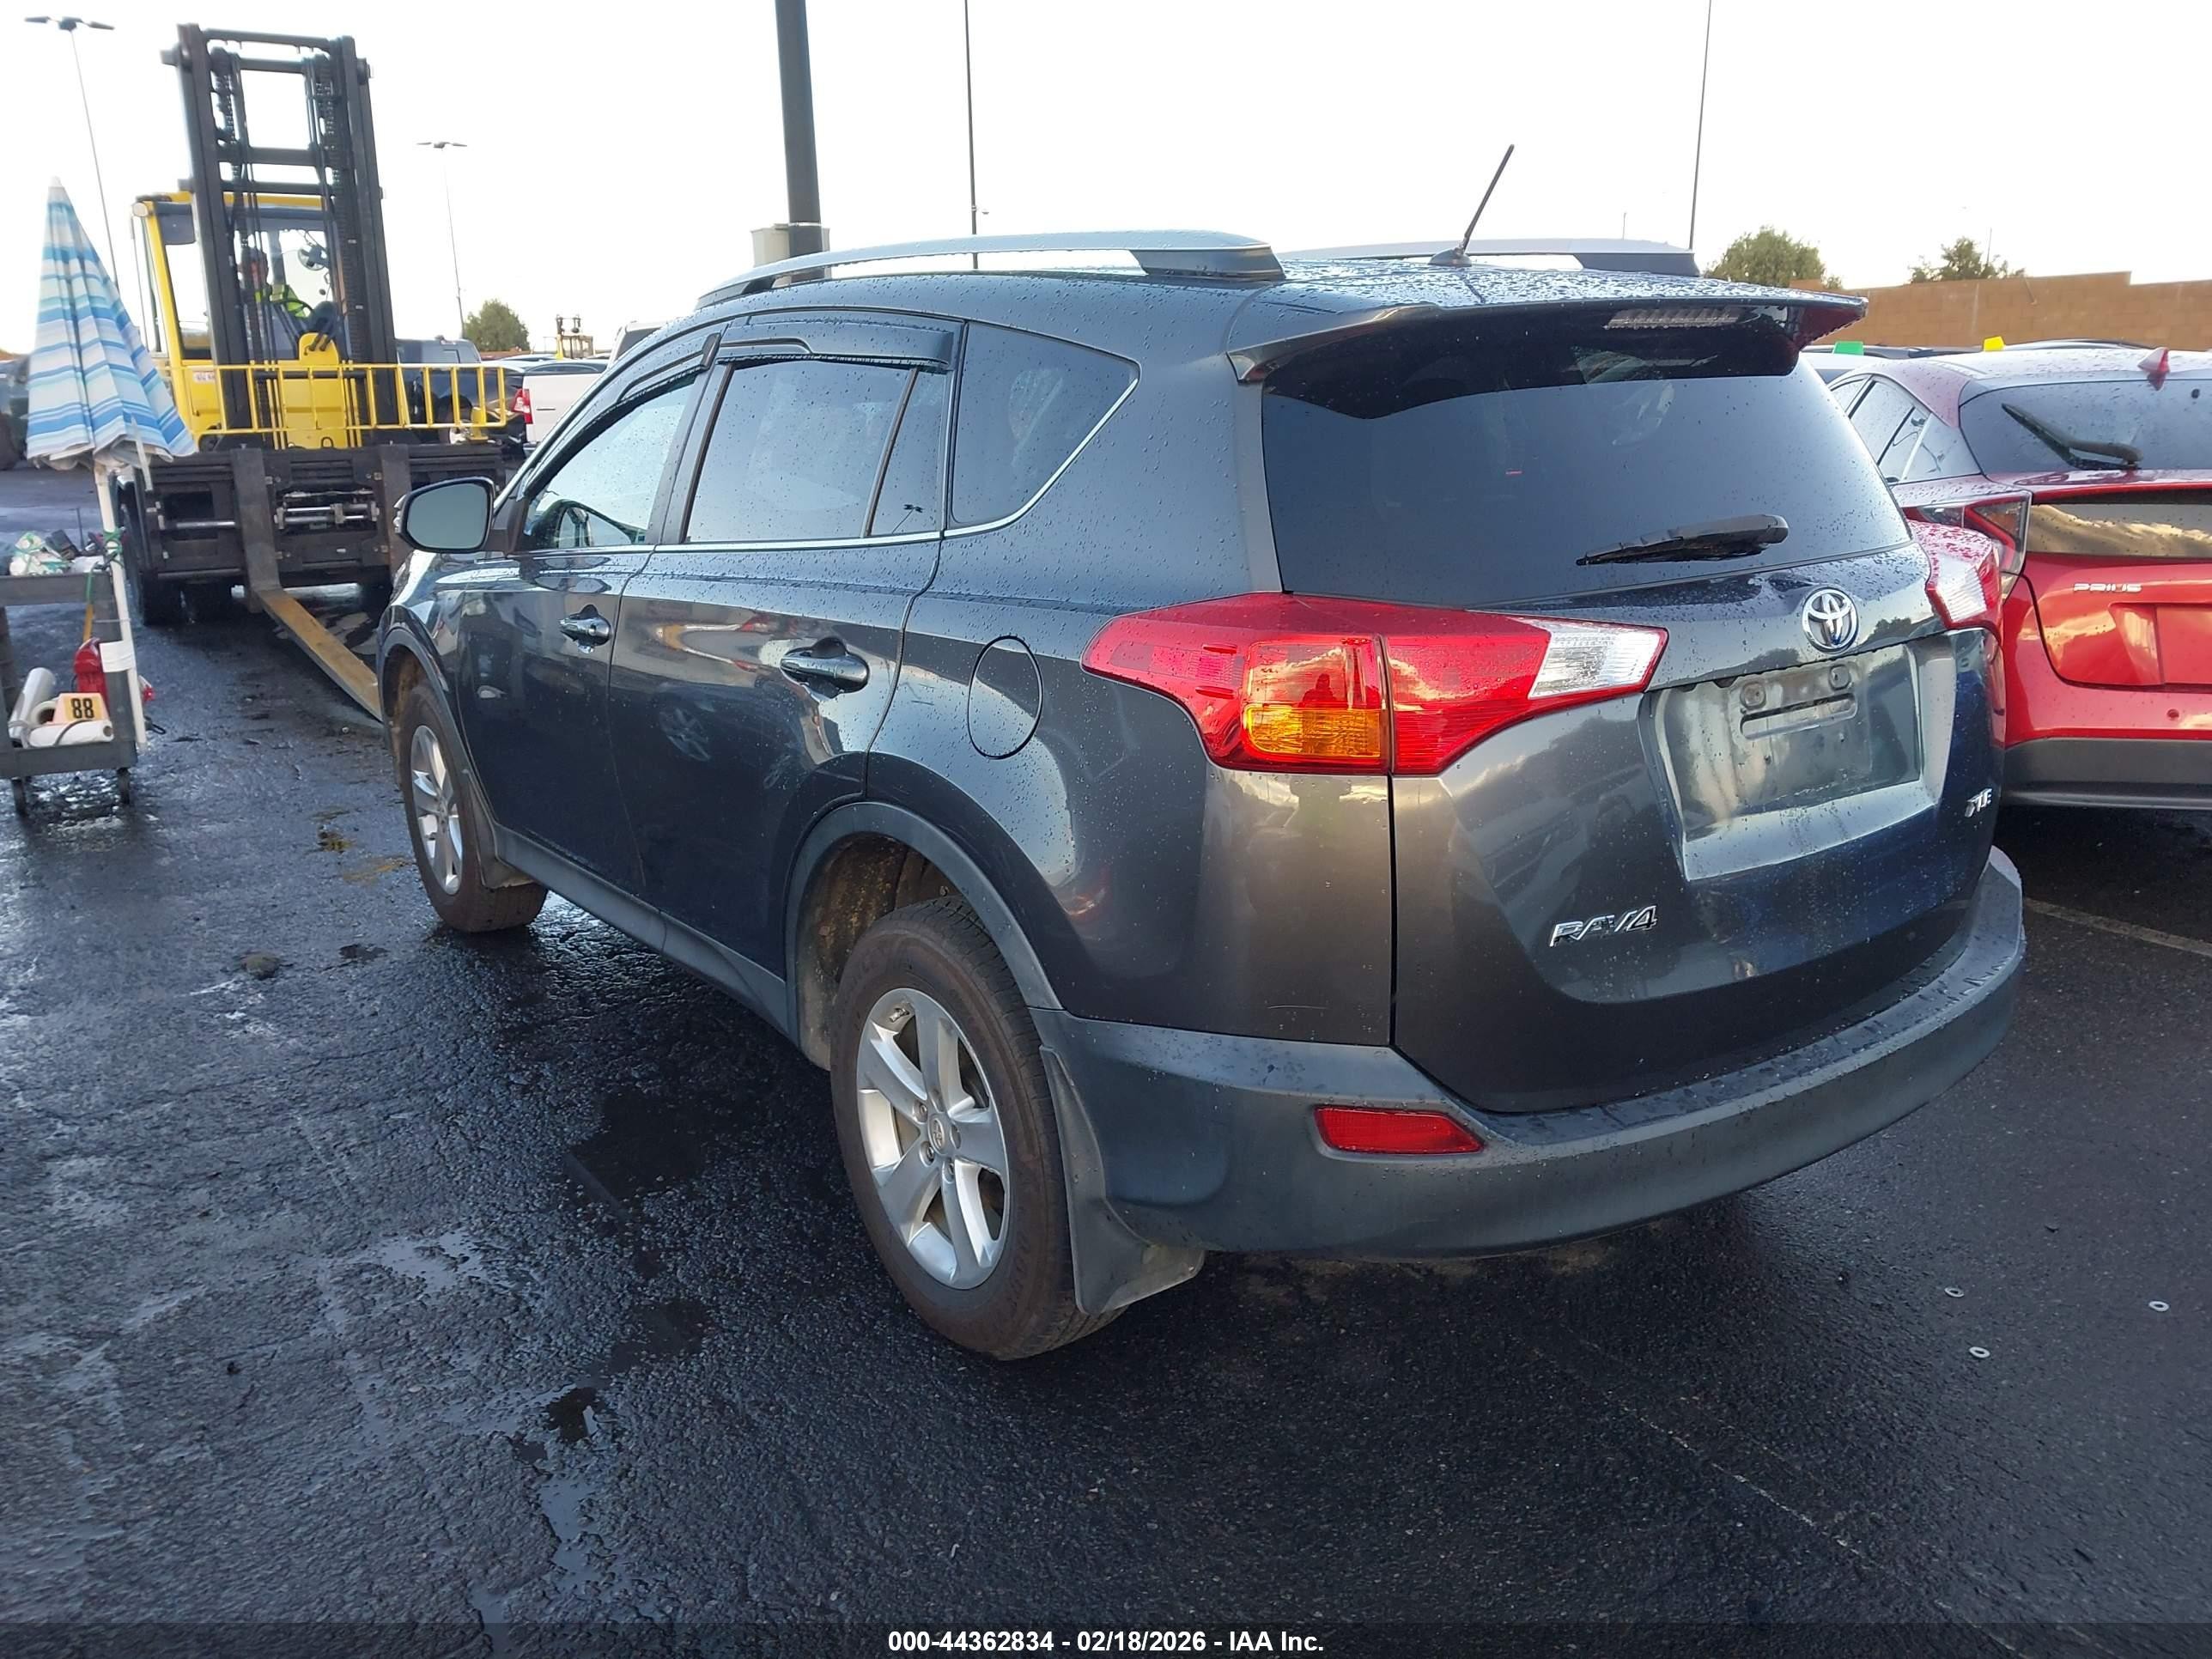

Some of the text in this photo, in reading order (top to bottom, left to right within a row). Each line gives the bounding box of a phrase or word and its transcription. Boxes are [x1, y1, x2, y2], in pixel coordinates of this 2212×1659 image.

[2074, 583, 2142, 593] PRIUS
[70, 697, 95, 719] 88
[1549, 904, 1659, 947] RAV4
